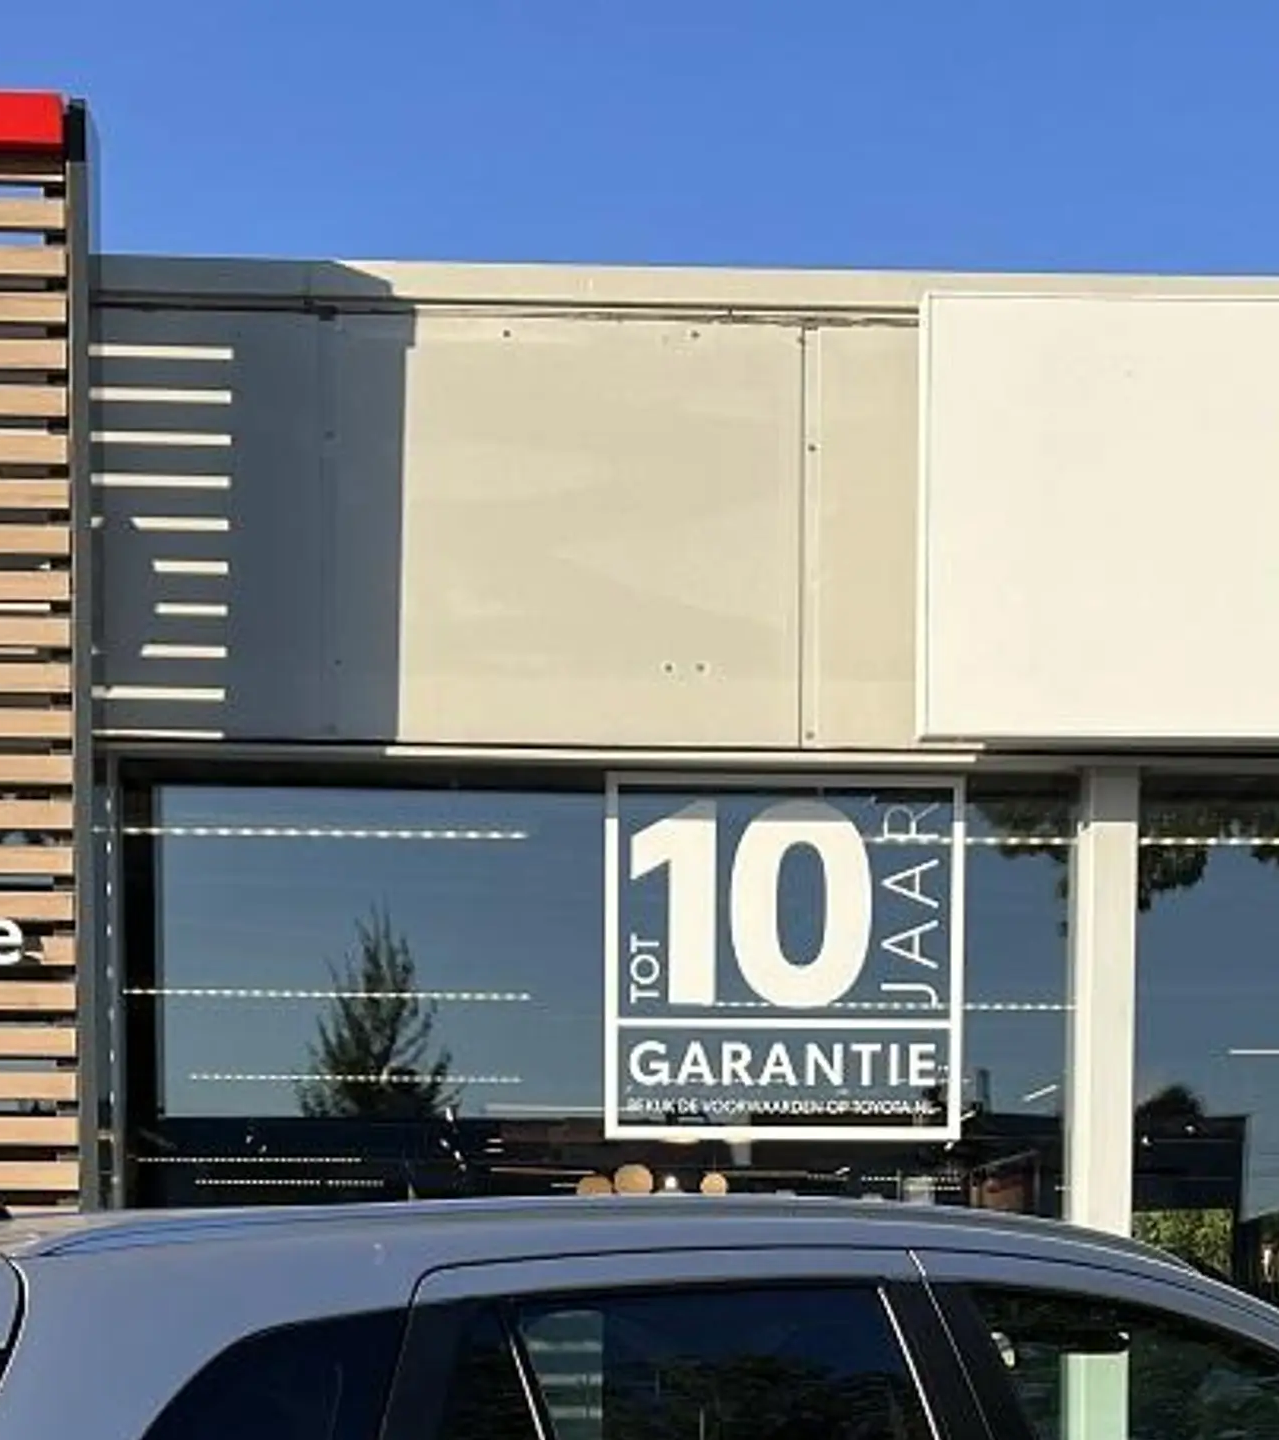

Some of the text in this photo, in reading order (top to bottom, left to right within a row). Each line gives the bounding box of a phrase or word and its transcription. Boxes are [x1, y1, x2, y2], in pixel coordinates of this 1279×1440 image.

[629, 800, 940, 1010] TOT 10 JAAR
[628, 1039, 939, 1088] GARANTIE
[677, 1096, 699, 1115] DE
[702, 1096, 824, 1115] VOORWAARDEN
[826, 1097, 850, 1116] OP
